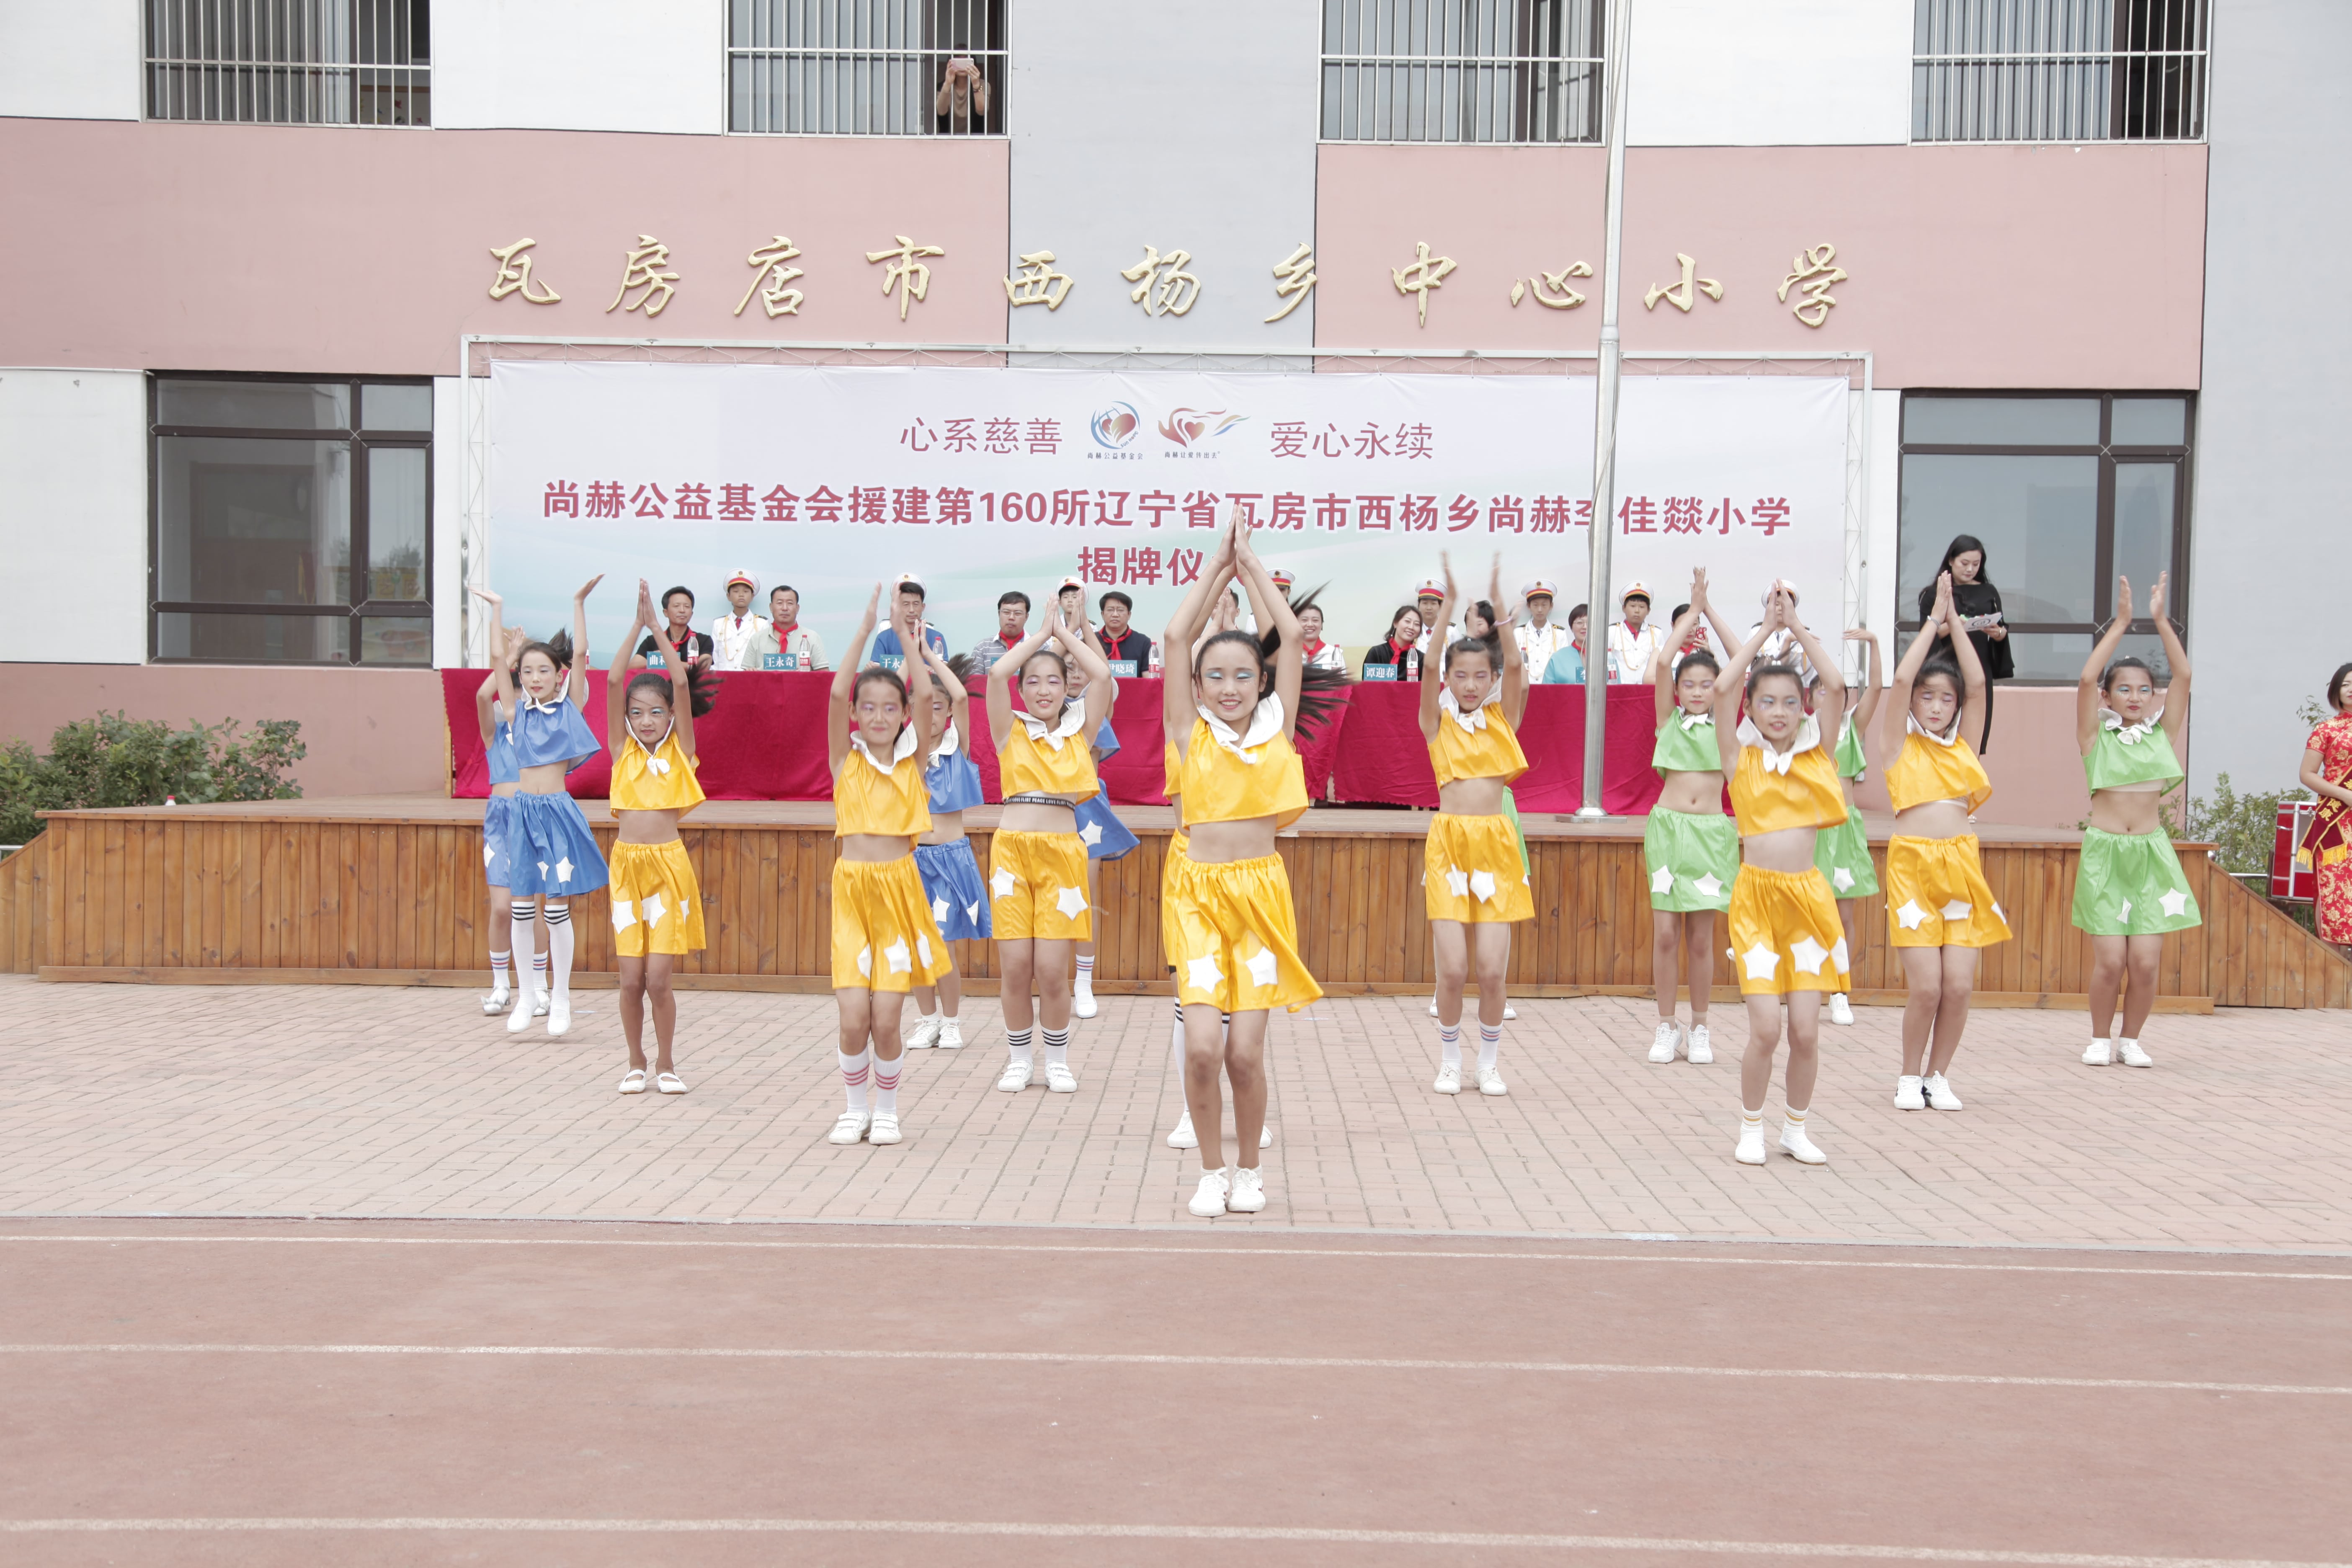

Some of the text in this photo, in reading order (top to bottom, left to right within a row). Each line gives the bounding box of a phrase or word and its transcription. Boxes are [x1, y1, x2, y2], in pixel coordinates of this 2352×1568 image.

[488, 234, 1849, 328] 瓦房店市西杨乡中心小学
[900, 415, 1063, 455] 心系慈善
[1270, 421, 1434, 459] 爱心永续
[1078, 546, 1245, 586] 揭牌仪
[766, 656, 794, 667] 王永奇
[882, 657, 904, 668] 于永
[1367, 667, 1395, 678] 谭迎春
